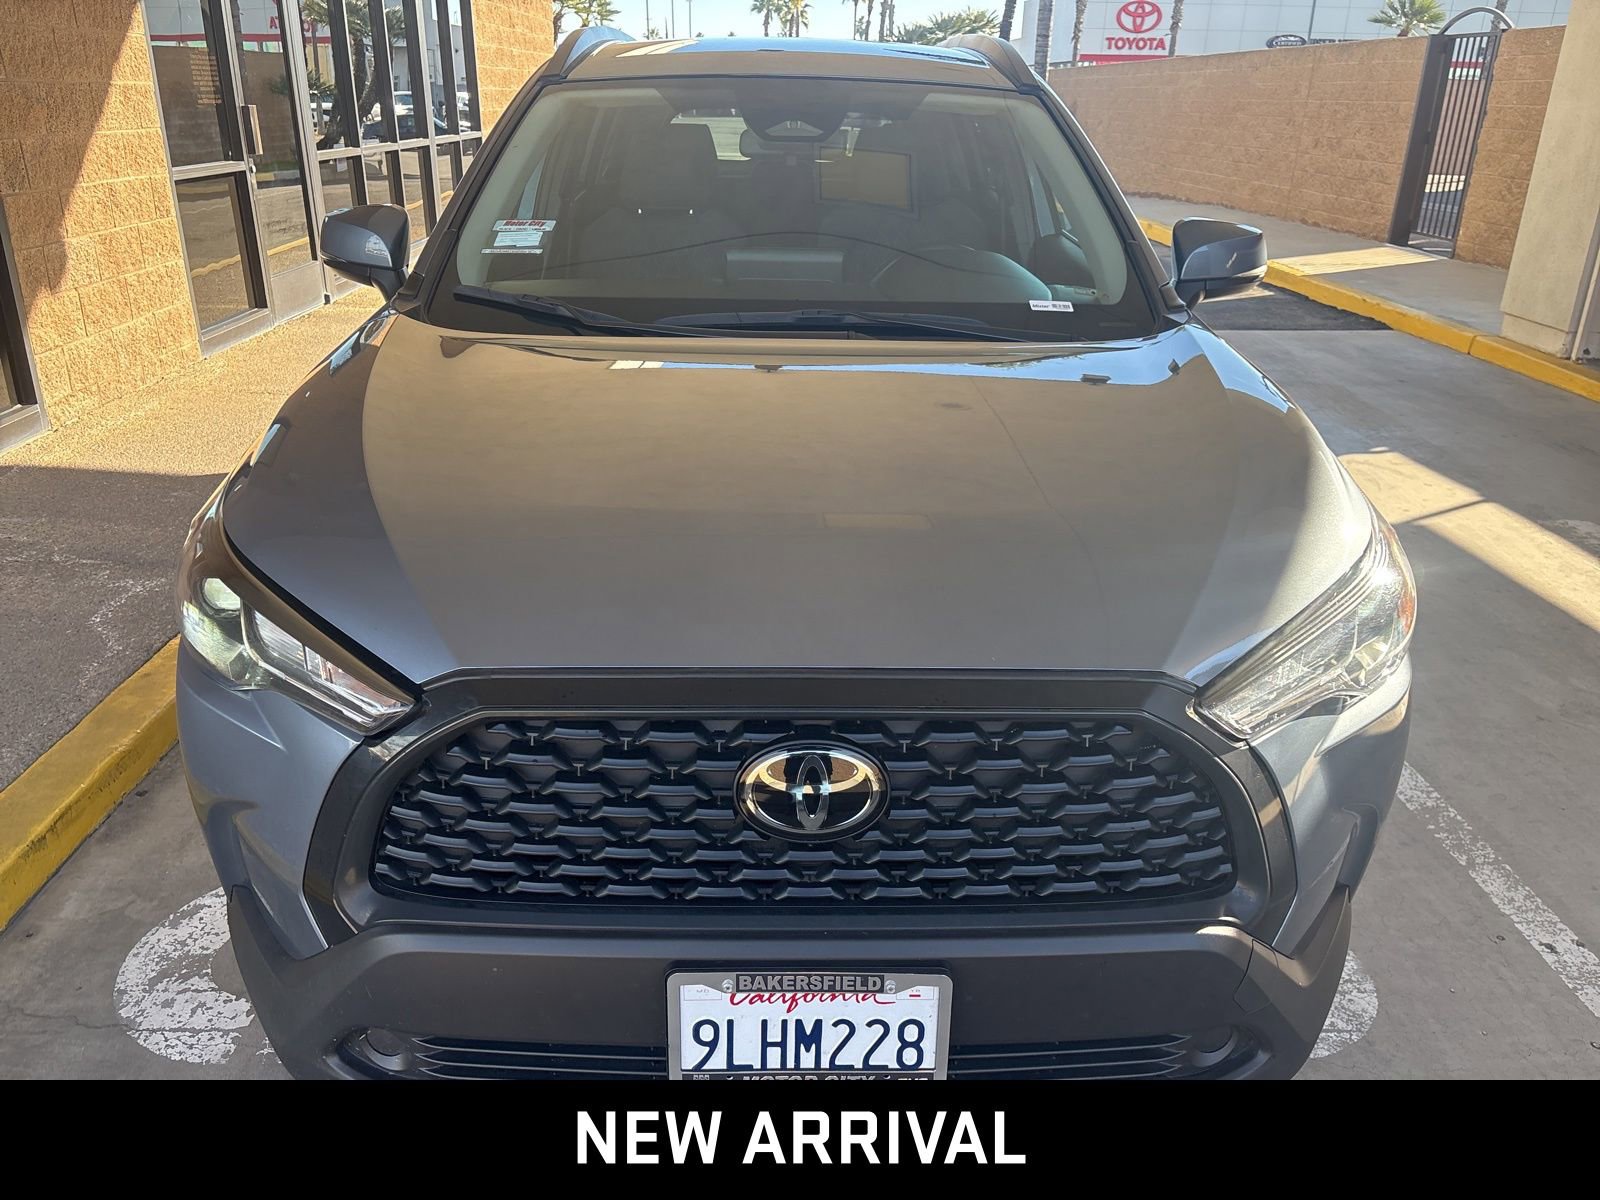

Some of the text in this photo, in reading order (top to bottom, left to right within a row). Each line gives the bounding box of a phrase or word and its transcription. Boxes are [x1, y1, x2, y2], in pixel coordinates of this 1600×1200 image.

[1105, 37, 1166, 51] TOYOTA
[739, 975, 882, 991] BAKERSFIELD
[691, 1018, 926, 1071] 9LHM228
